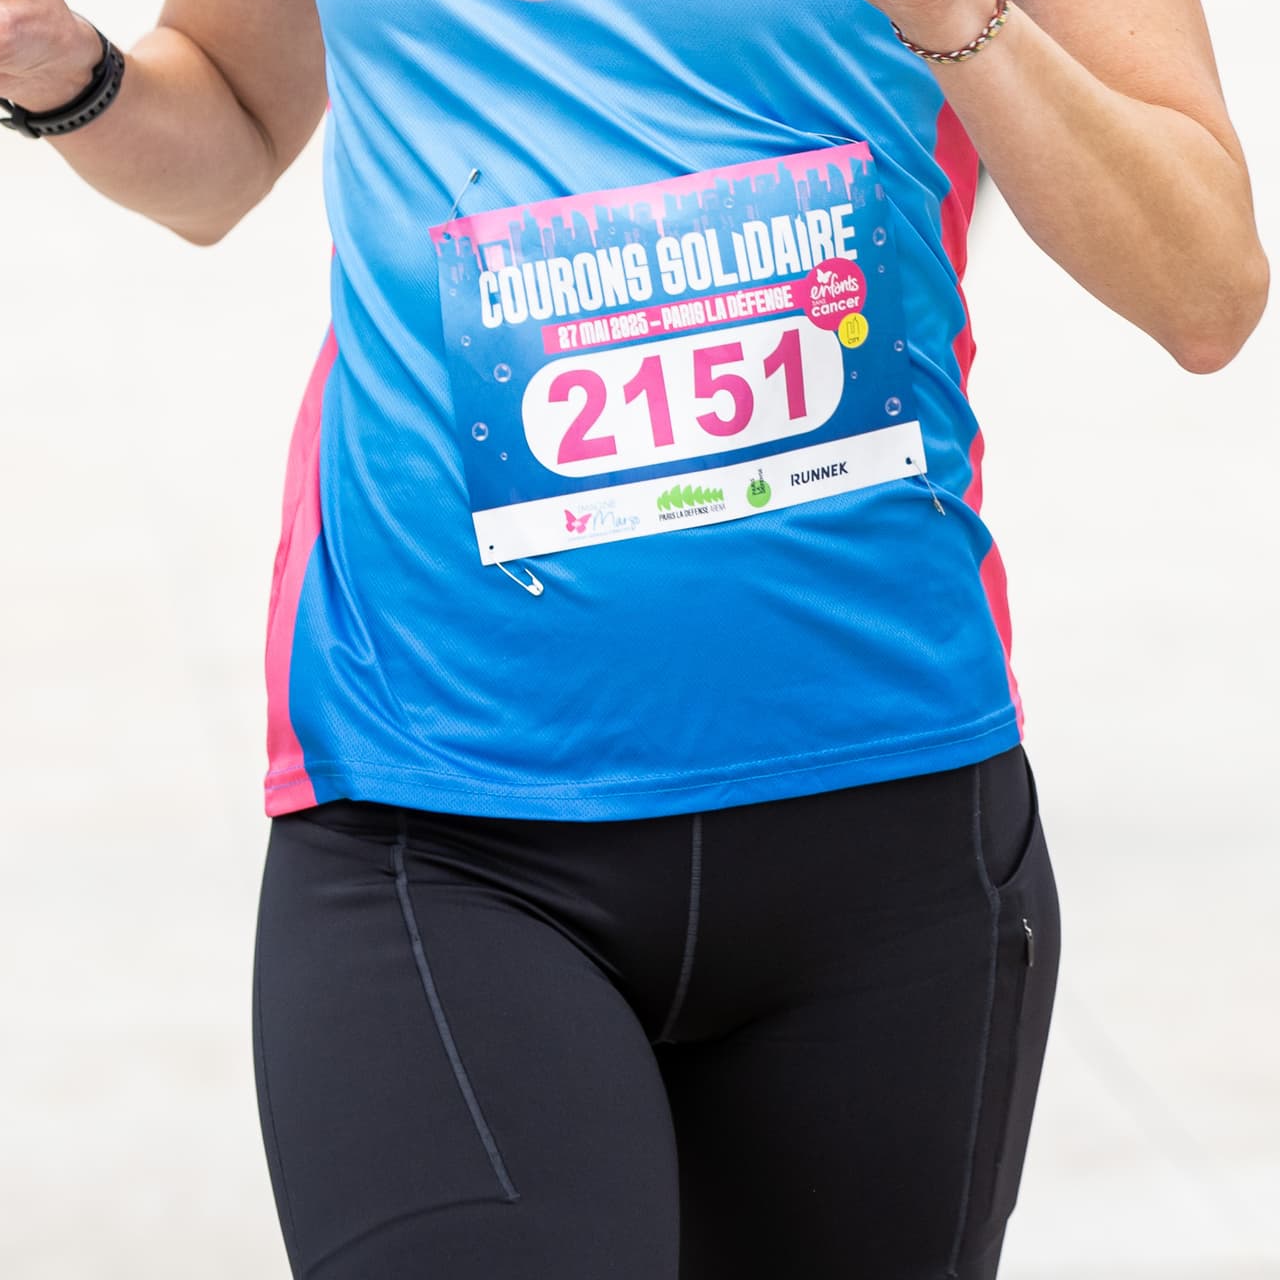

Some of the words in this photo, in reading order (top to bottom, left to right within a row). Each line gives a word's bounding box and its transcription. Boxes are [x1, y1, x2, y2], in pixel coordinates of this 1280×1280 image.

[479, 243, 653, 328] COURONS
[656, 203, 858, 295] SOLIDAIRE
[810, 273, 859, 300] enfants
[558, 324, 578, 349] 27
[579, 319, 611, 345] MAI
[609, 312, 649, 340] 2025
[661, 301, 705, 331] PARIS
[707, 296, 728, 322] LA
[725, 284, 795, 318] DÉFENSE
[811, 296, 860, 317] cancer
[547, 328, 808, 465] 2151
[790, 461, 849, 487] RUNNEK
[658, 512, 676, 522] PARIS
[676, 511, 685, 520] LA
